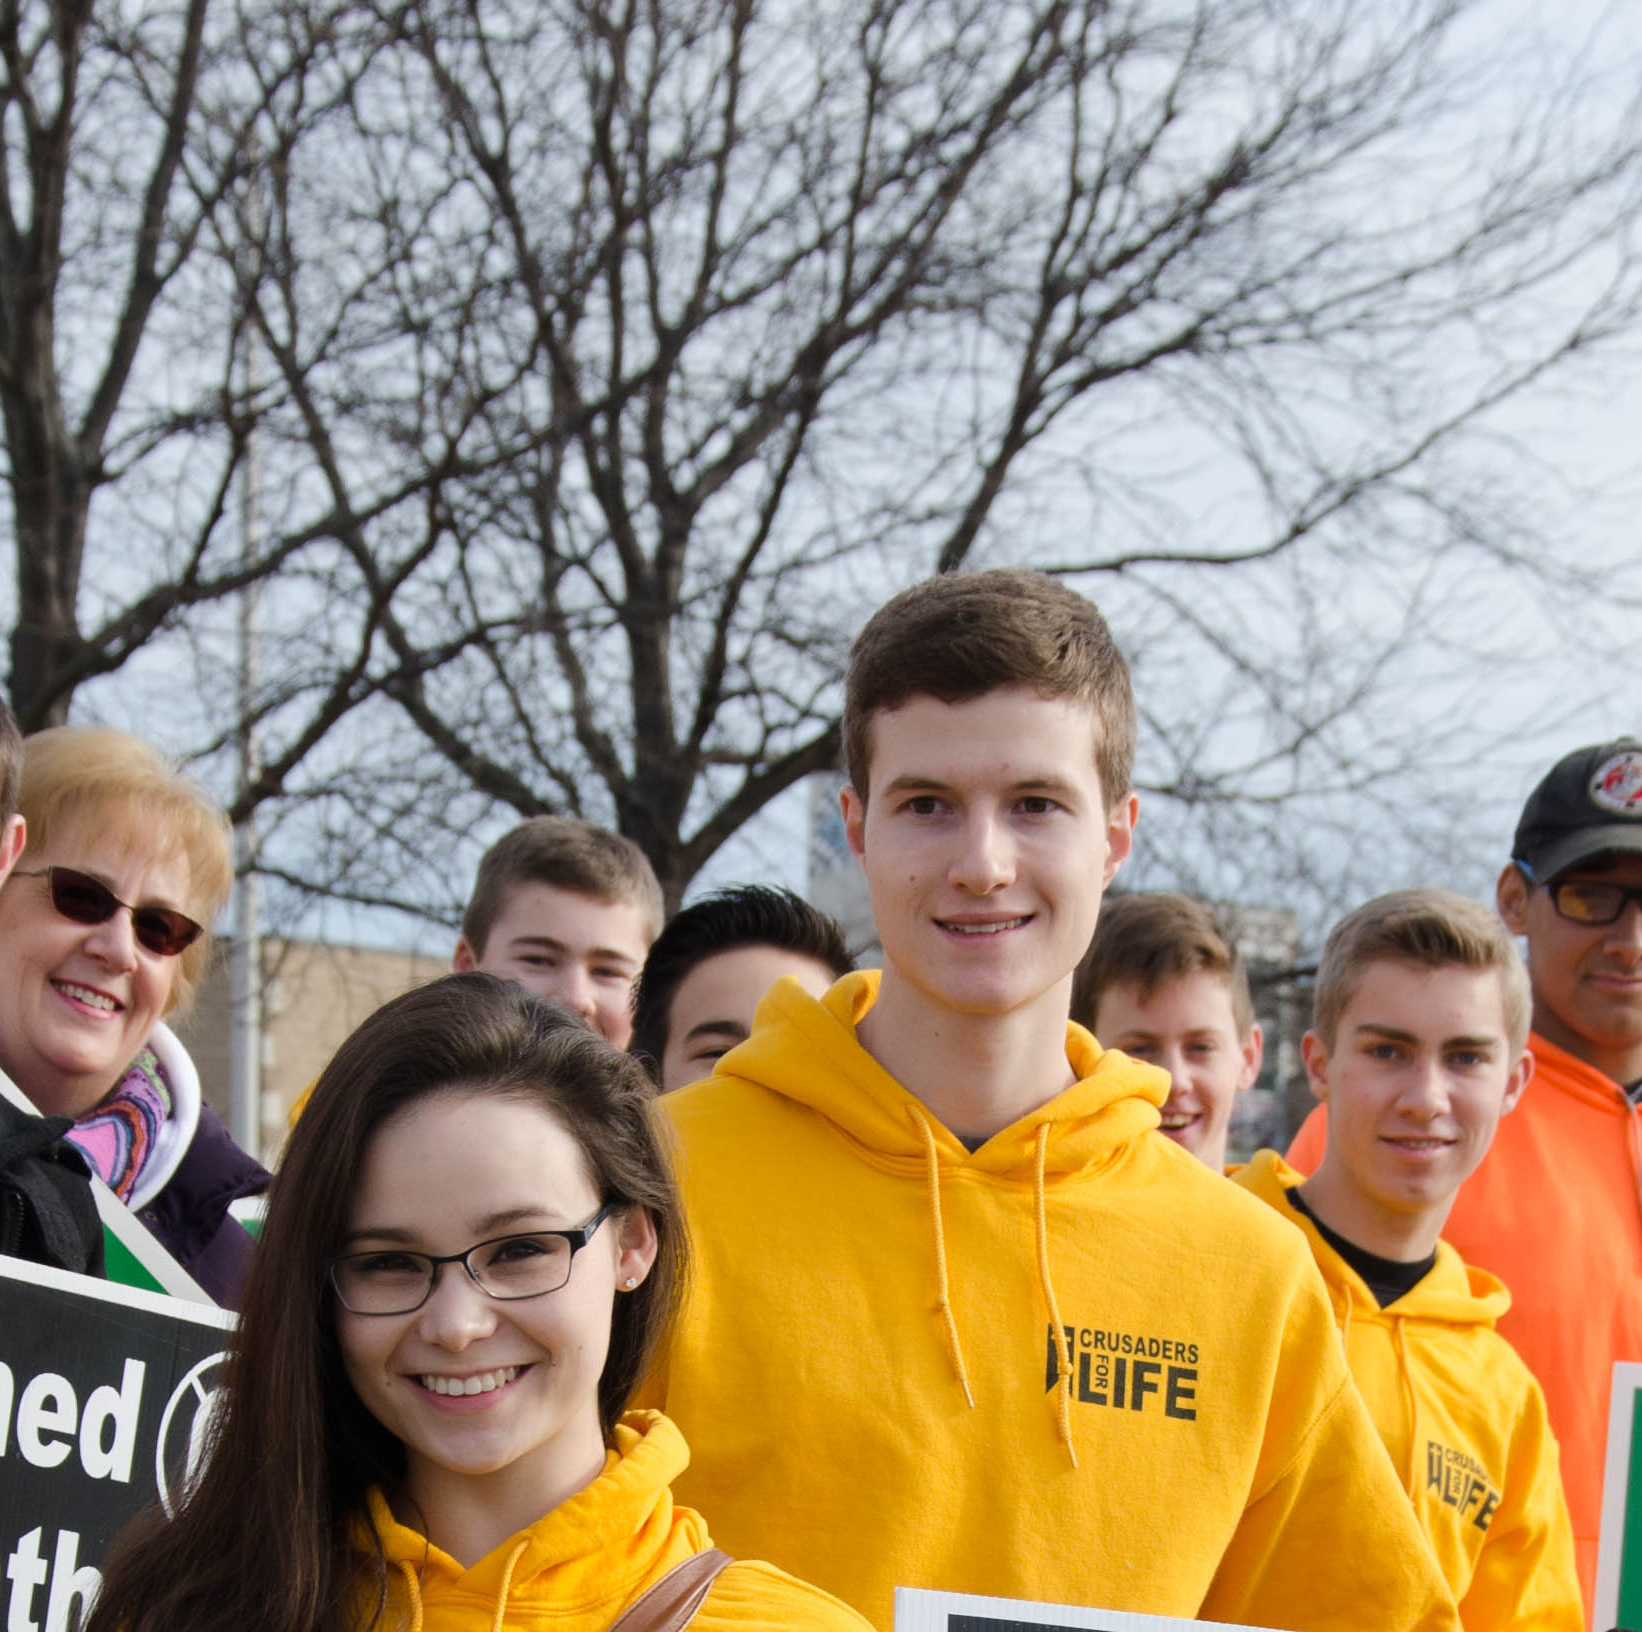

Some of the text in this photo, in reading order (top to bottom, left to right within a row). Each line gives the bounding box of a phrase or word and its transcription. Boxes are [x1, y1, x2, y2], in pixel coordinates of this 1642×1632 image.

[1080, 1328, 1199, 1364] CRUSADERS
[1095, 1354, 1109, 1389] FOR
[1078, 1352, 1198, 1421] LIFE
[1443, 1466, 1499, 1532] LIFE
